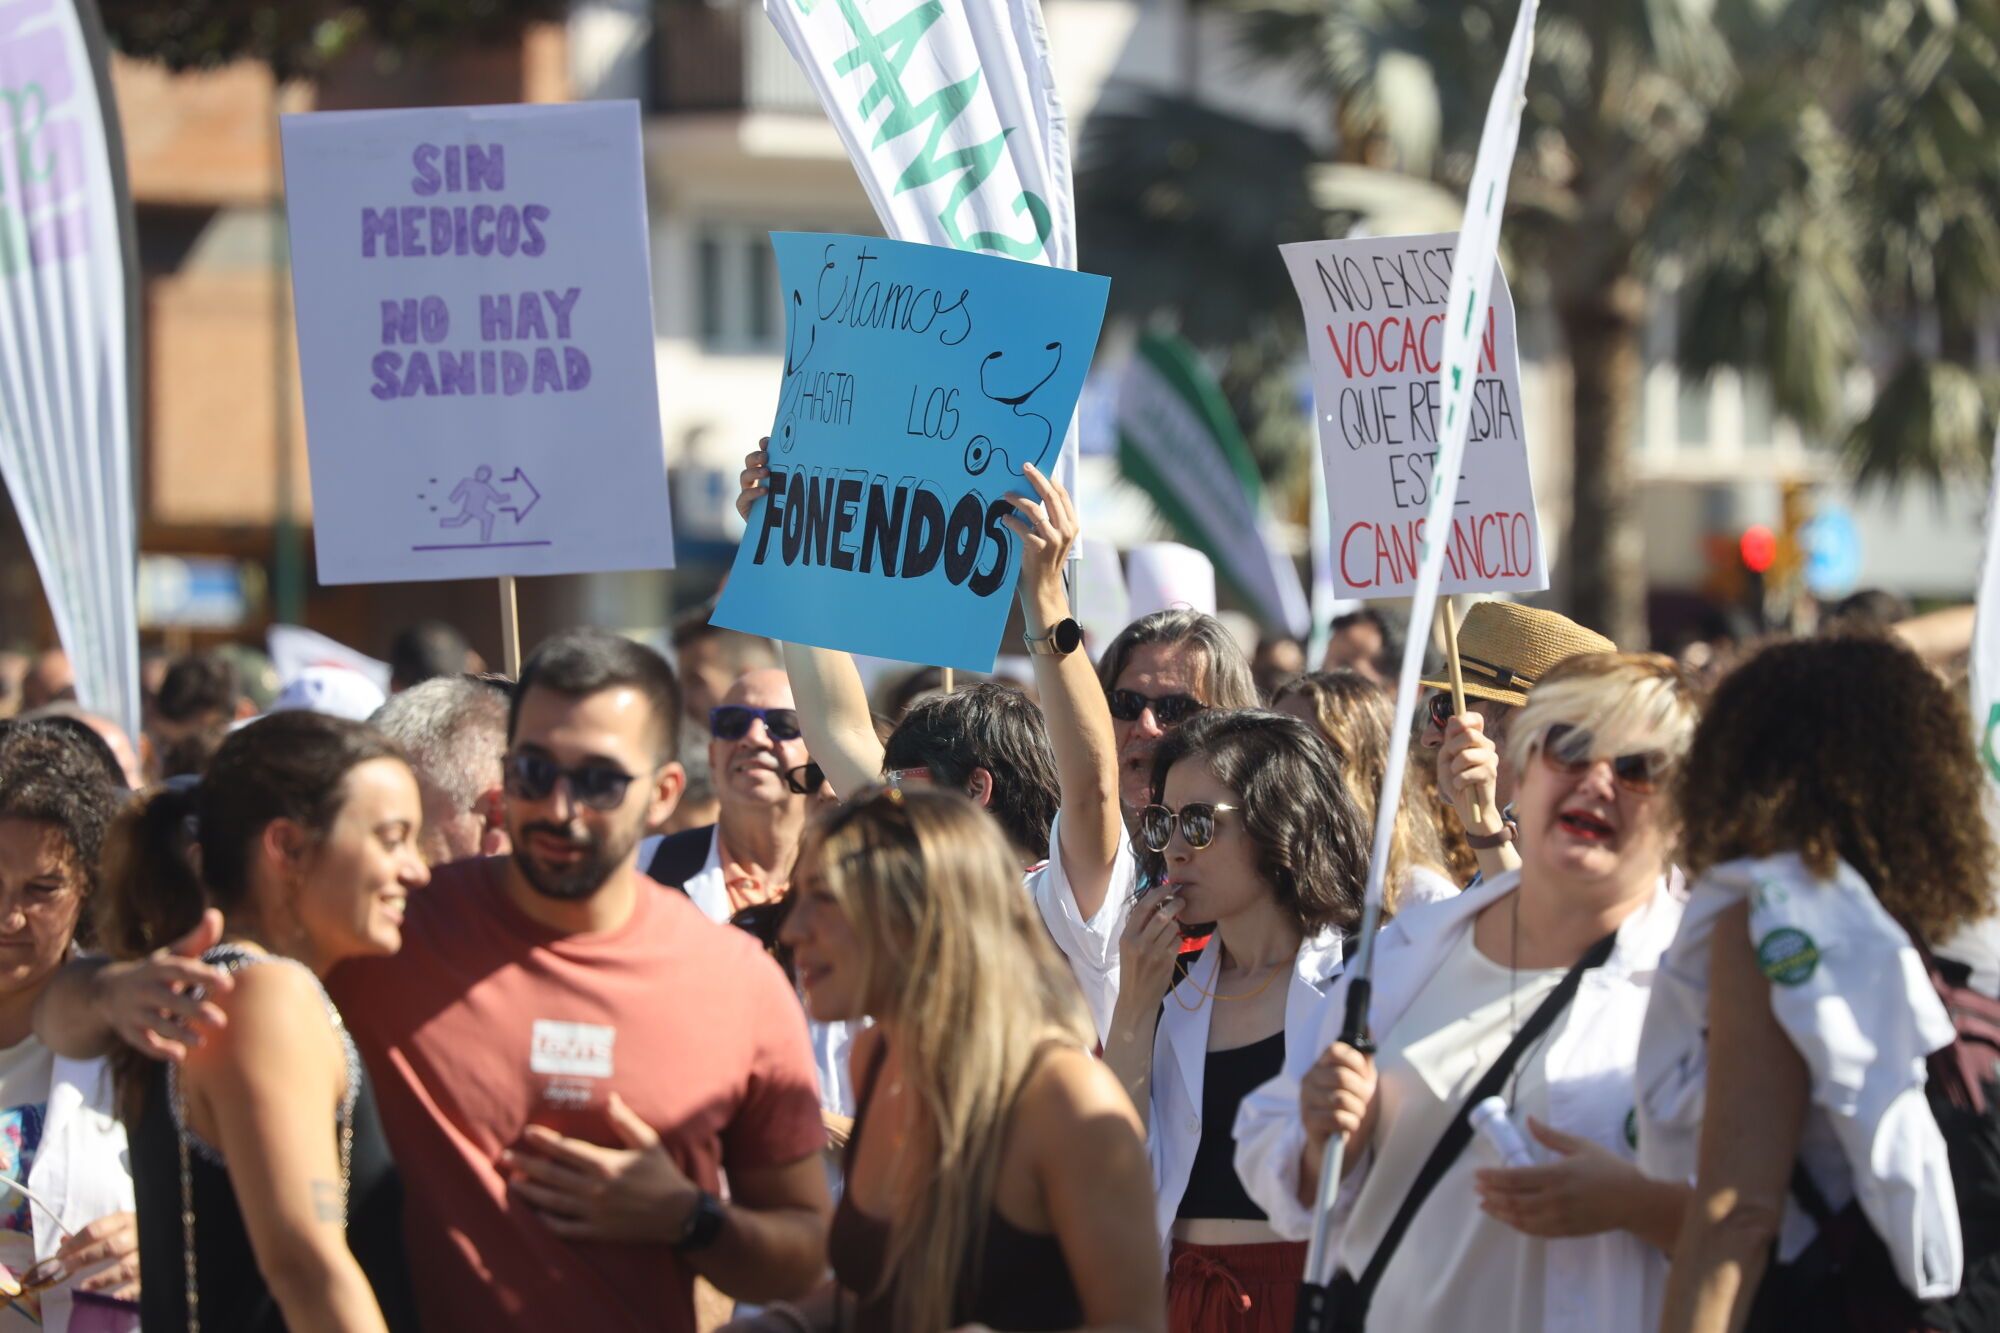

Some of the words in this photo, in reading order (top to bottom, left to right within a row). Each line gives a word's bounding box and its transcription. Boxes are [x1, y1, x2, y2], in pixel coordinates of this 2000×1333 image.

[411, 143, 505, 196] SIN
[361, 204, 551, 259] MEDICOS
[817, 243, 972, 346] Estamos
[1315, 253, 1373, 312] NO
[1372, 247, 1454, 309] EXIST
[380, 295, 450, 346] NO
[479, 287, 582, 341] HAY
[1326, 305, 1497, 379] VOCACN
[370, 346, 592, 400] SANIDAD
[799, 371, 855, 425] HASTA
[906, 385, 960, 441] LOS
[1340, 385, 1403, 450] QUE
[1409, 379, 1518, 443] REISTA
[1389, 452, 1471, 508] EST
[752, 464, 1017, 598] FONENDOS
